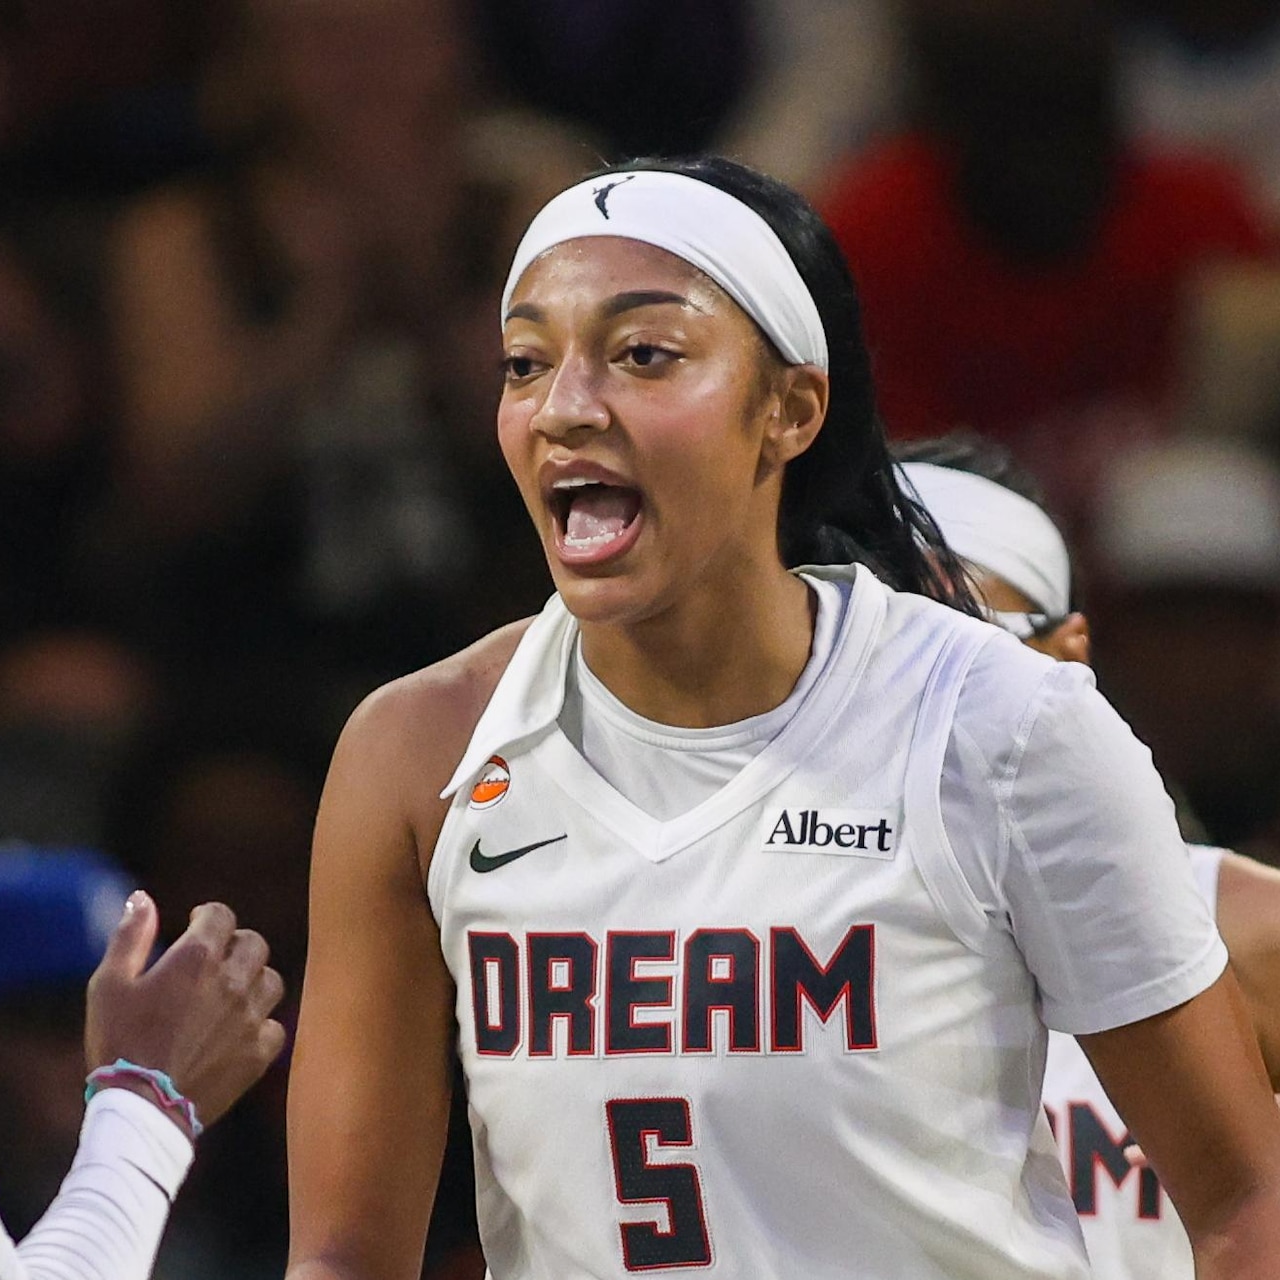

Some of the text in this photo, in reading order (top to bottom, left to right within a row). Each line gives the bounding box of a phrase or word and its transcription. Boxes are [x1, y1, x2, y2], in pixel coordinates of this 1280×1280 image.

[765, 809, 893, 852] Albert
[467, 923, 880, 1057] DREAM
[605, 1096, 713, 1272] 5
